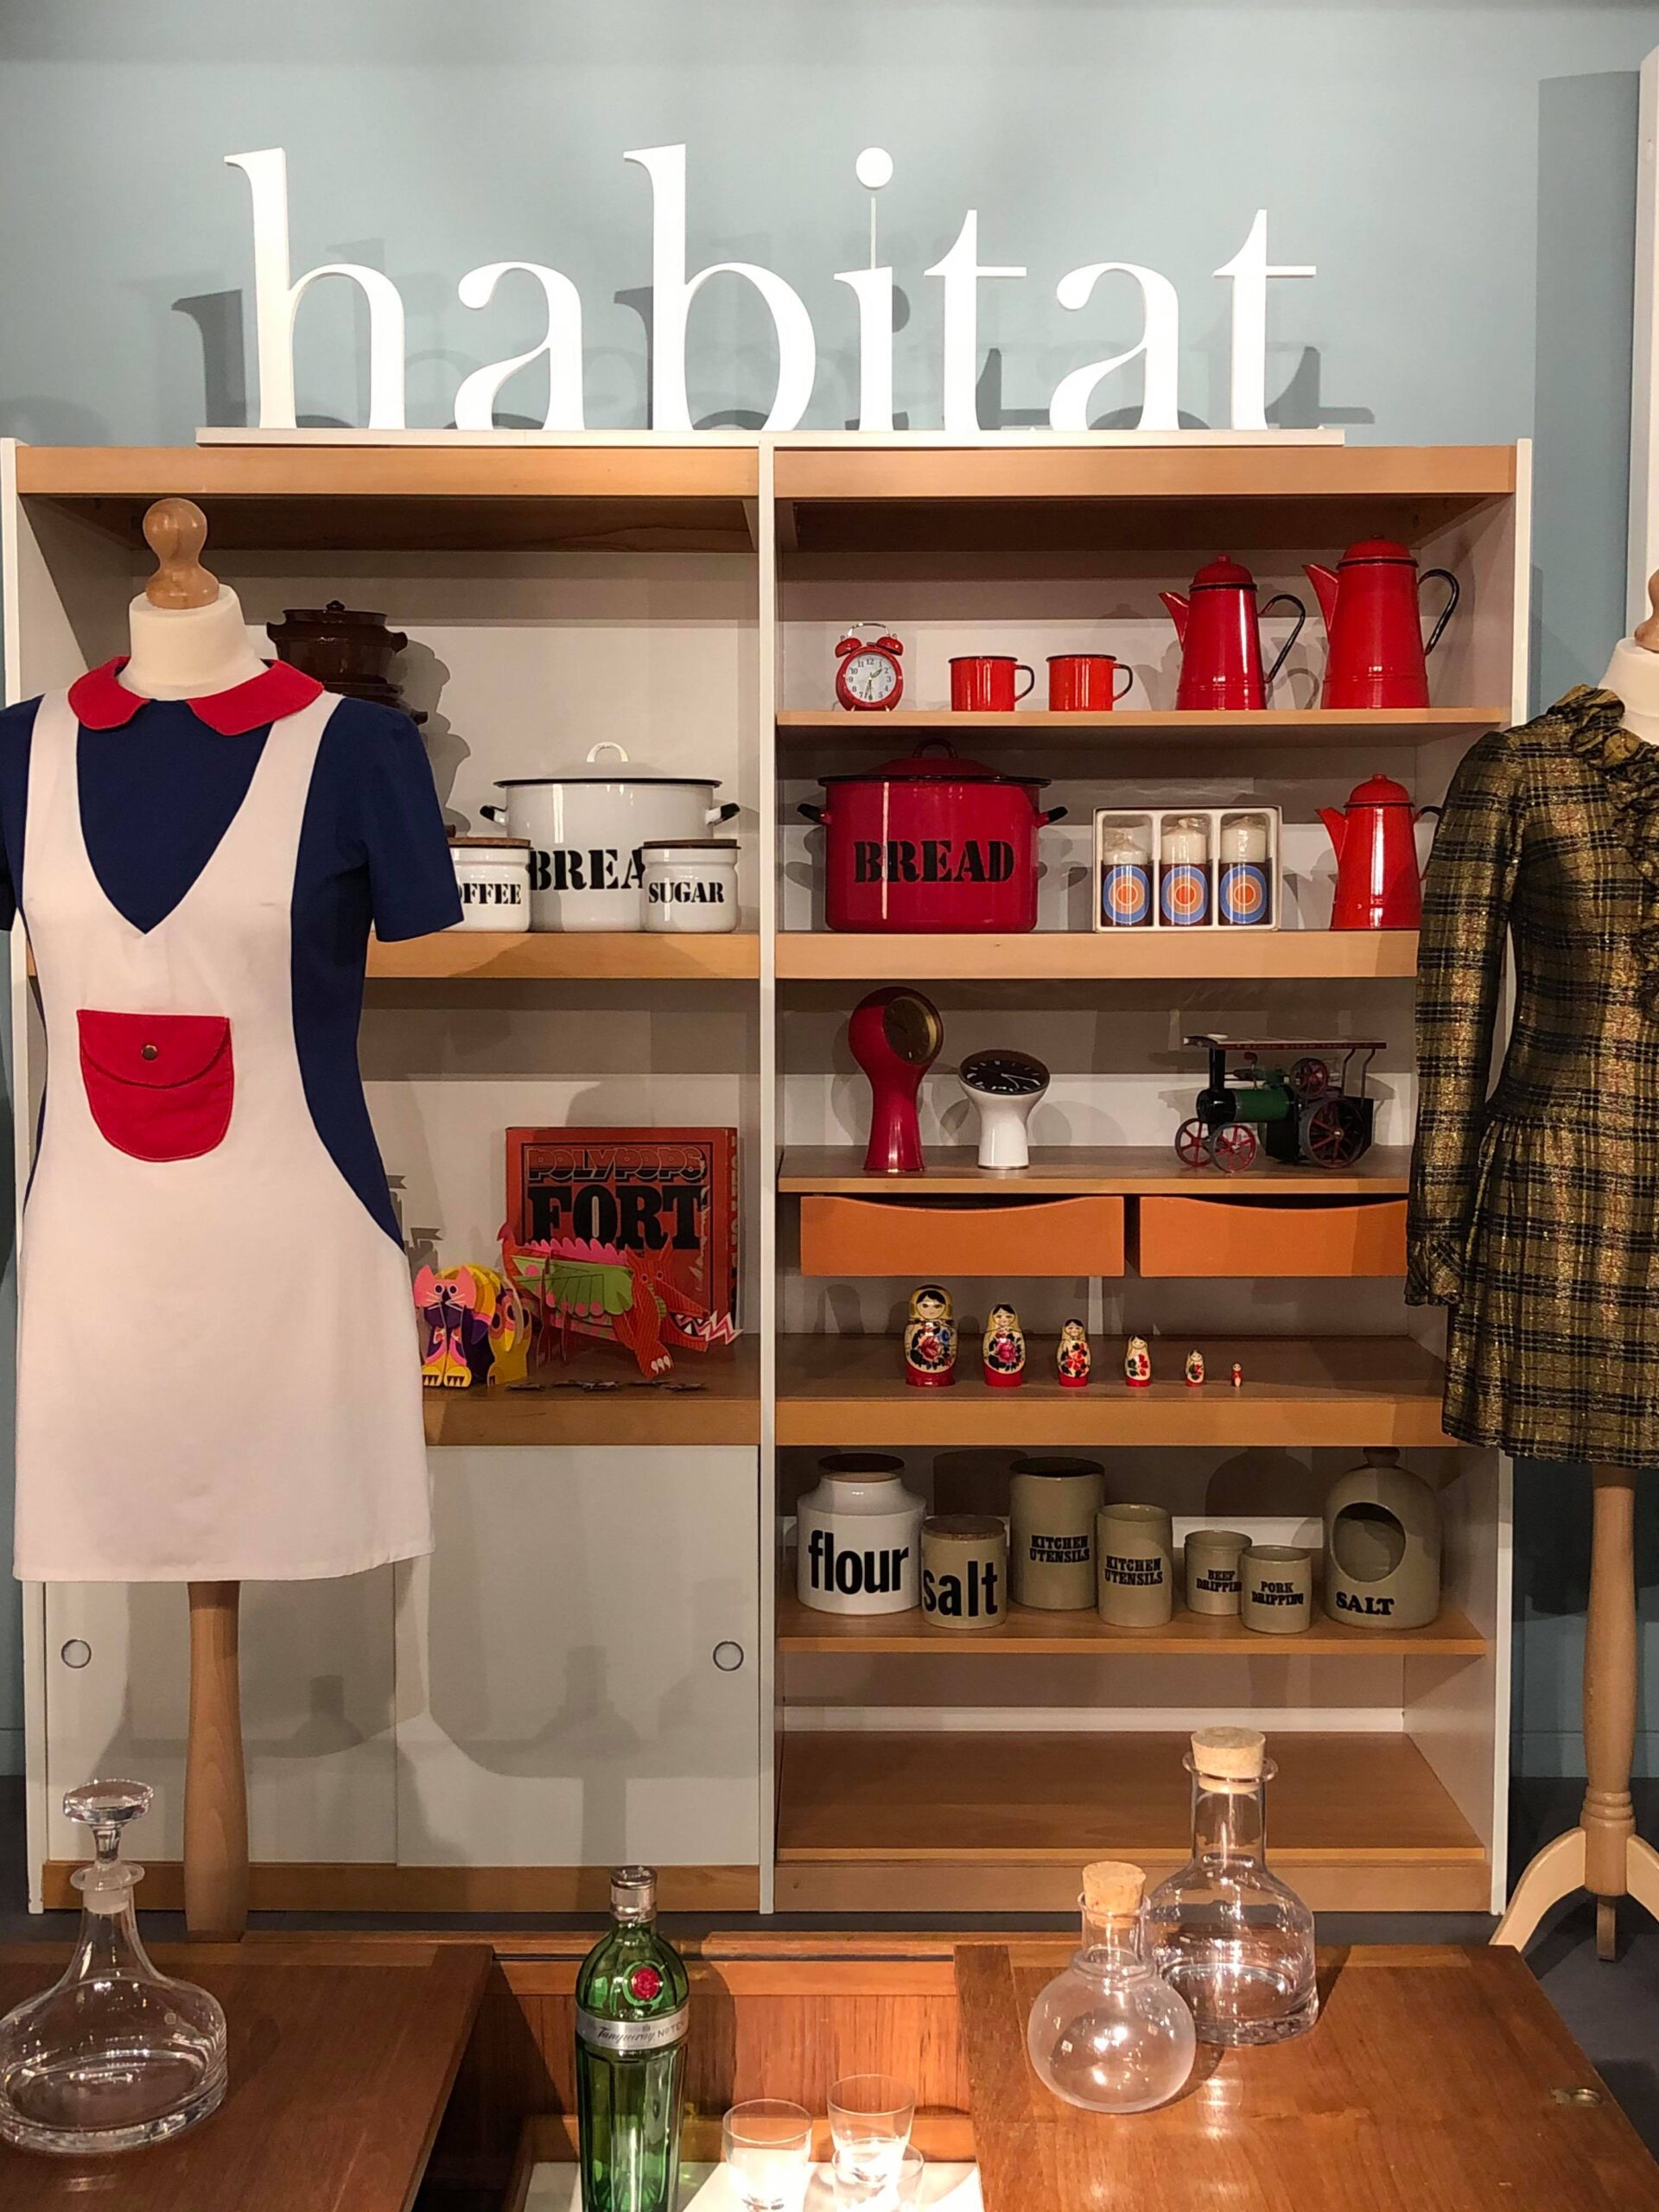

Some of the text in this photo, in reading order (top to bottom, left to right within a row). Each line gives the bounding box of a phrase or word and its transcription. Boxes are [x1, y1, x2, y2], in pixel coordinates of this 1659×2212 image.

[224, 143, 1318, 430] habitat
[528, 849, 644, 890] BREA
[854, 840, 1014, 883] BREAD
[459, 882, 522, 905] FFEE
[648, 881, 724, 905] SUGAR
[527, 1146, 708, 1181] POLYPOPS
[528, 1184, 711, 1249] FORT
[1031, 1535, 1089, 1550] KITCHEN
[808, 1529, 909, 1595] flour
[1029, 1548, 1090, 1563] UTENSILS
[1106, 1555, 1161, 1572] KITCHEN
[1104, 1568, 1163, 1586] UTENSILS
[1207, 1569, 1236, 1580] BEEF
[923, 1560, 998, 1617] salt
[1261, 1581, 1294, 1593] PORK
[1336, 1592, 1395, 1616] SALT
[597, 2027, 656, 2044] Tanqueray
